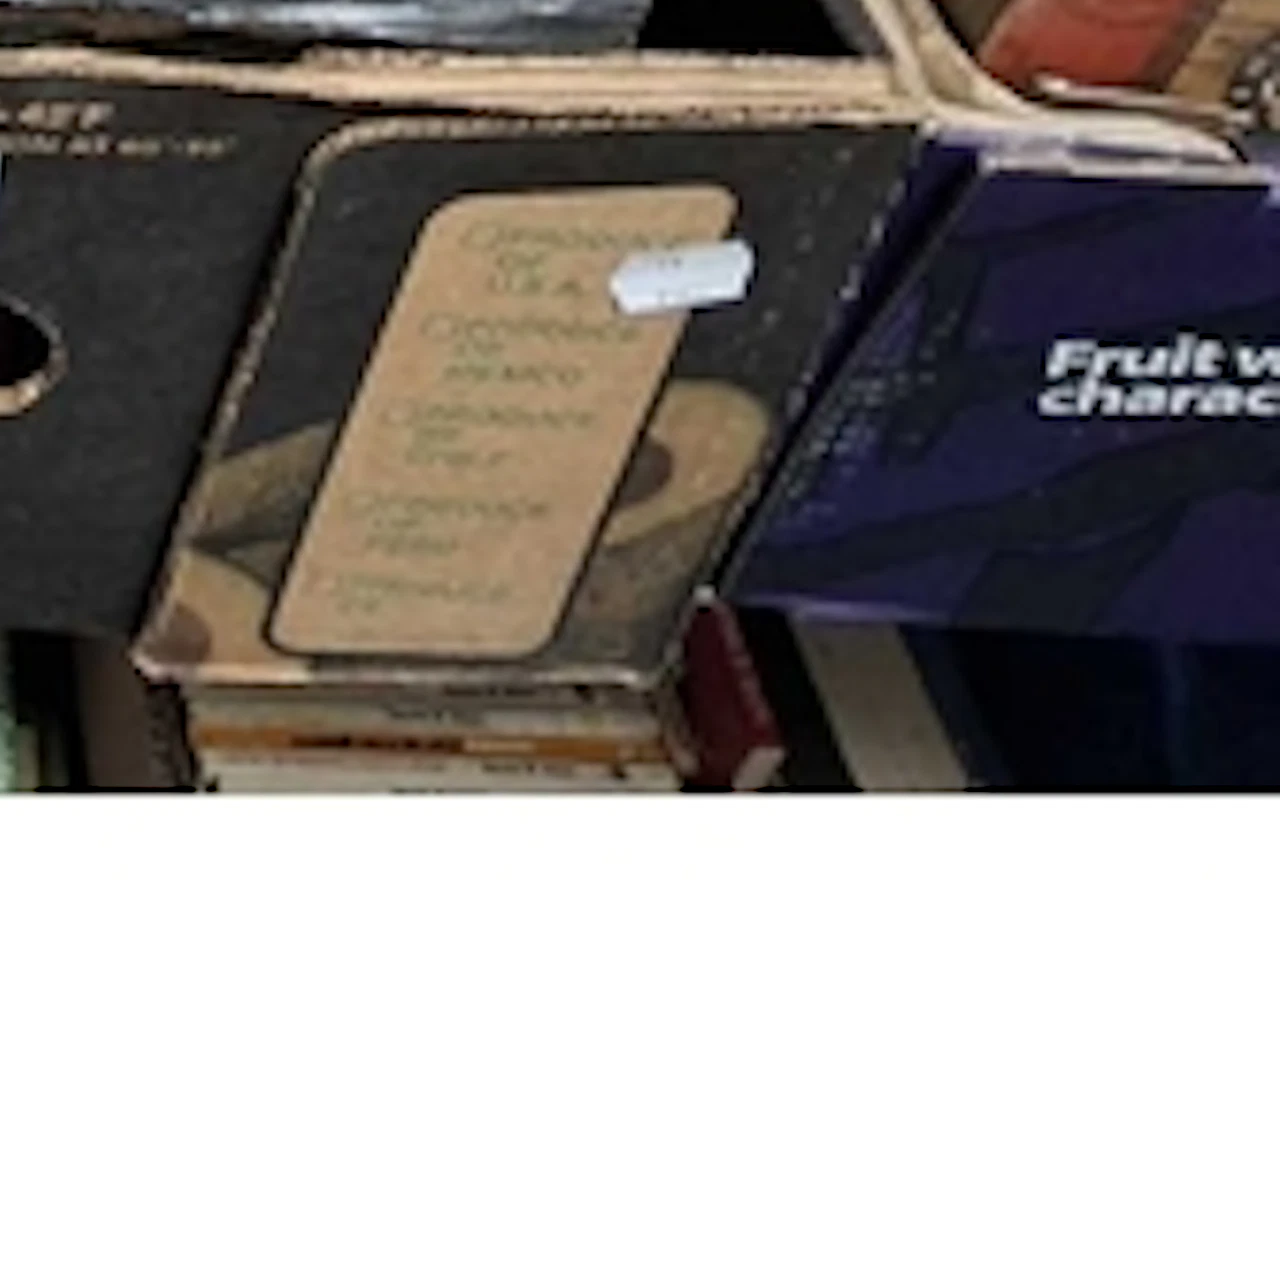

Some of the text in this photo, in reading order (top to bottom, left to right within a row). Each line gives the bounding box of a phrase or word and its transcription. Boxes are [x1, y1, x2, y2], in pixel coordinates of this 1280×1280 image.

[1043, 331, 1280, 381] Fruit w
[1036, 376, 1280, 419] charac
